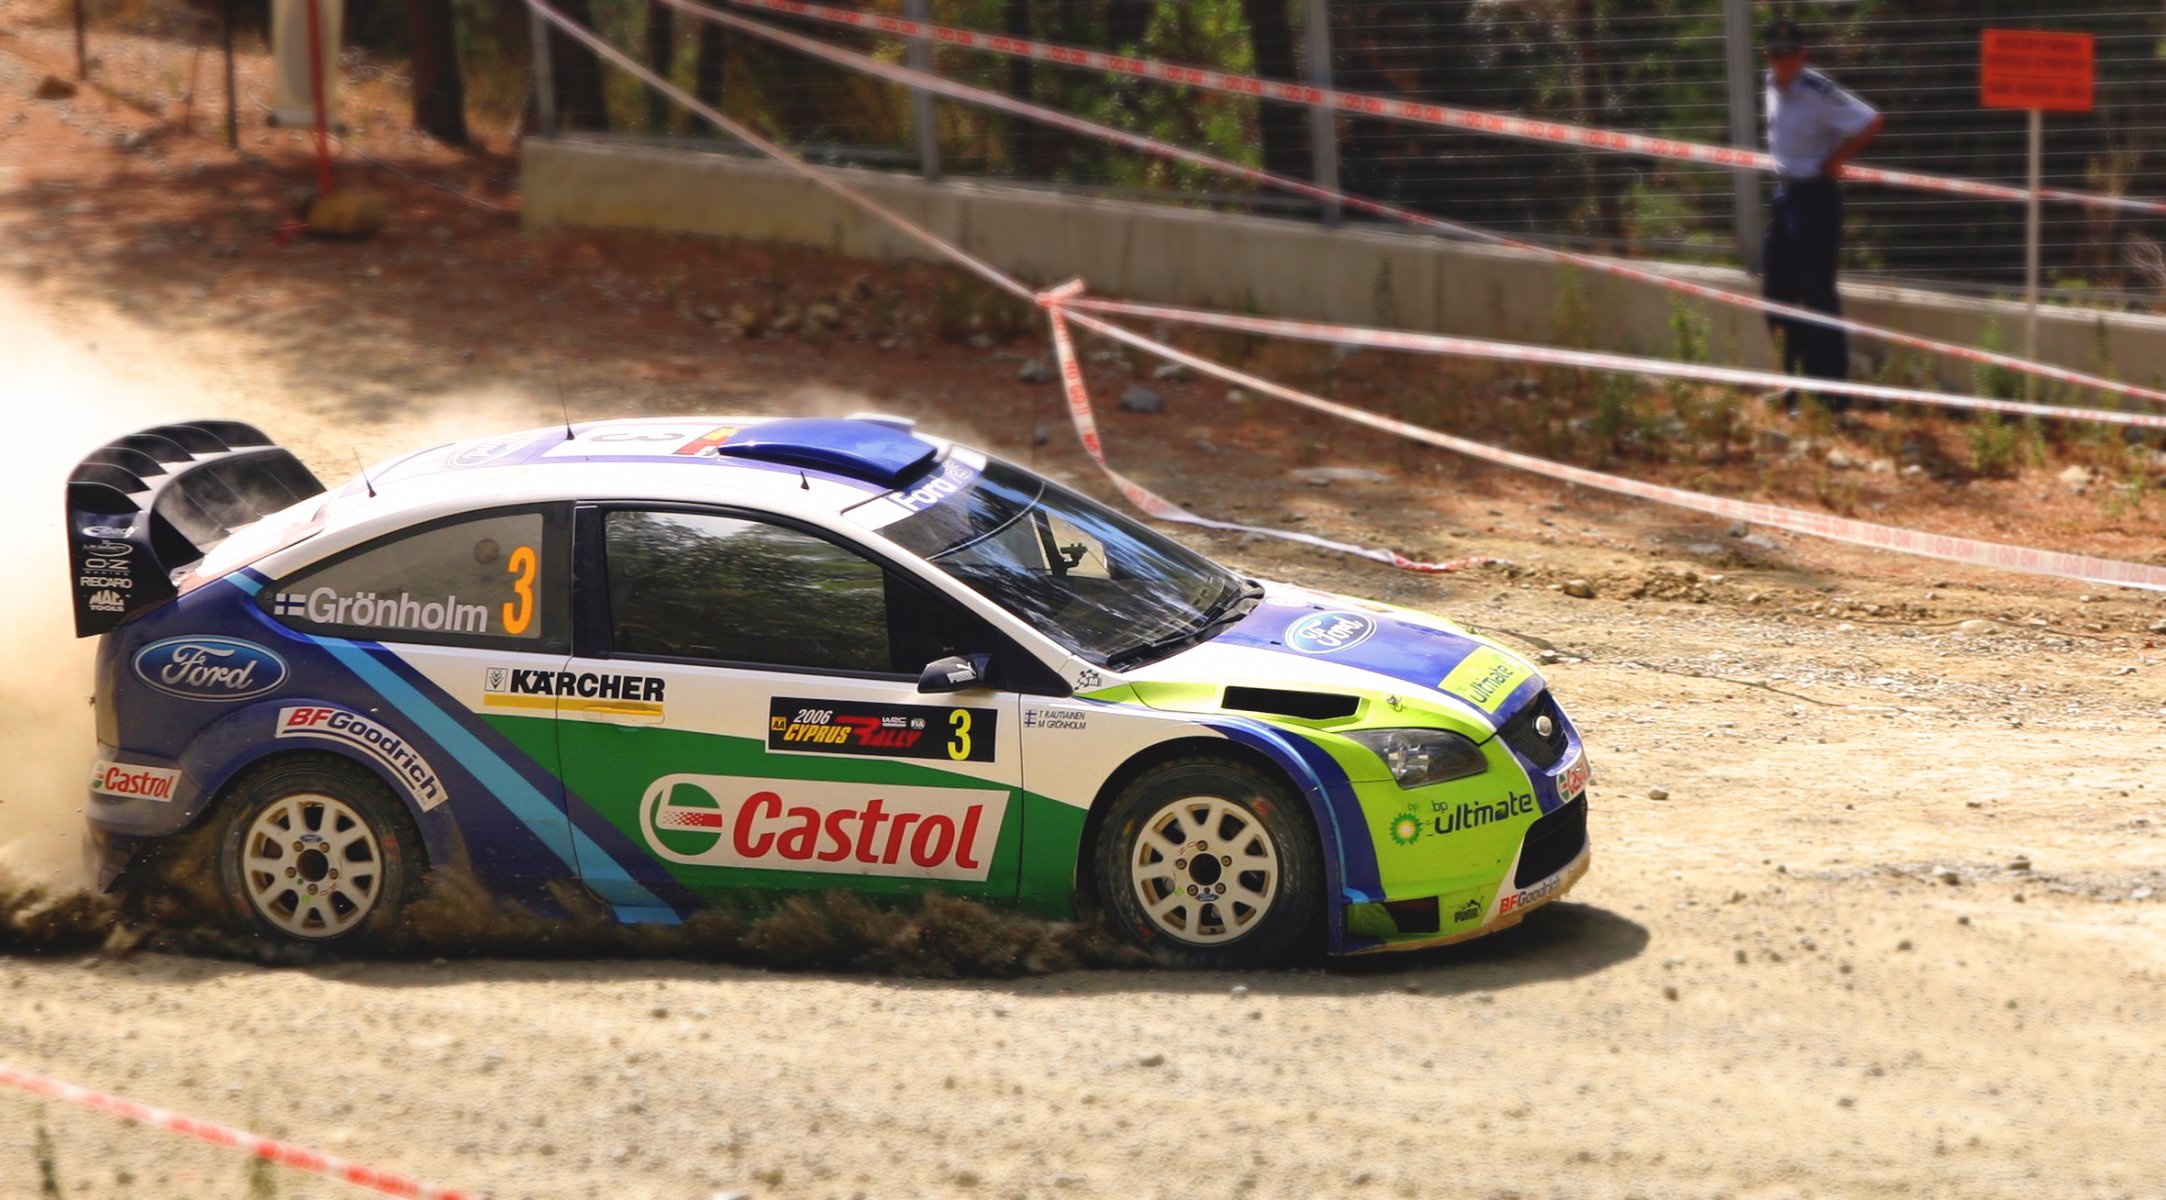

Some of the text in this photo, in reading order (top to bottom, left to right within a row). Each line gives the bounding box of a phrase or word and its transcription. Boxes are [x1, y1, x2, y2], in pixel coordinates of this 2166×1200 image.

[80, 576, 133, 589] RECARO
[502, 545, 538, 635] 3
[307, 586, 488, 632] Grönholm
[1297, 615, 1365, 647] Ford
[161, 644, 258, 690] Ford
[510, 668, 665, 702] KÄRCHER
[1469, 664, 1514, 703] ultimate
[773, 719, 786, 730] AA
[784, 714, 923, 748] CYPRUS RALLY
[794, 708, 833, 724] 2006
[946, 708, 972, 761] 3
[286, 707, 437, 800] BFGoodrich
[104, 766, 175, 799] Castrol
[1432, 800, 1449, 814] bp
[1434, 791, 1533, 834] ultimate
[733, 791, 984, 869] Castrol
[1499, 875, 1561, 913] BFGoodrich
